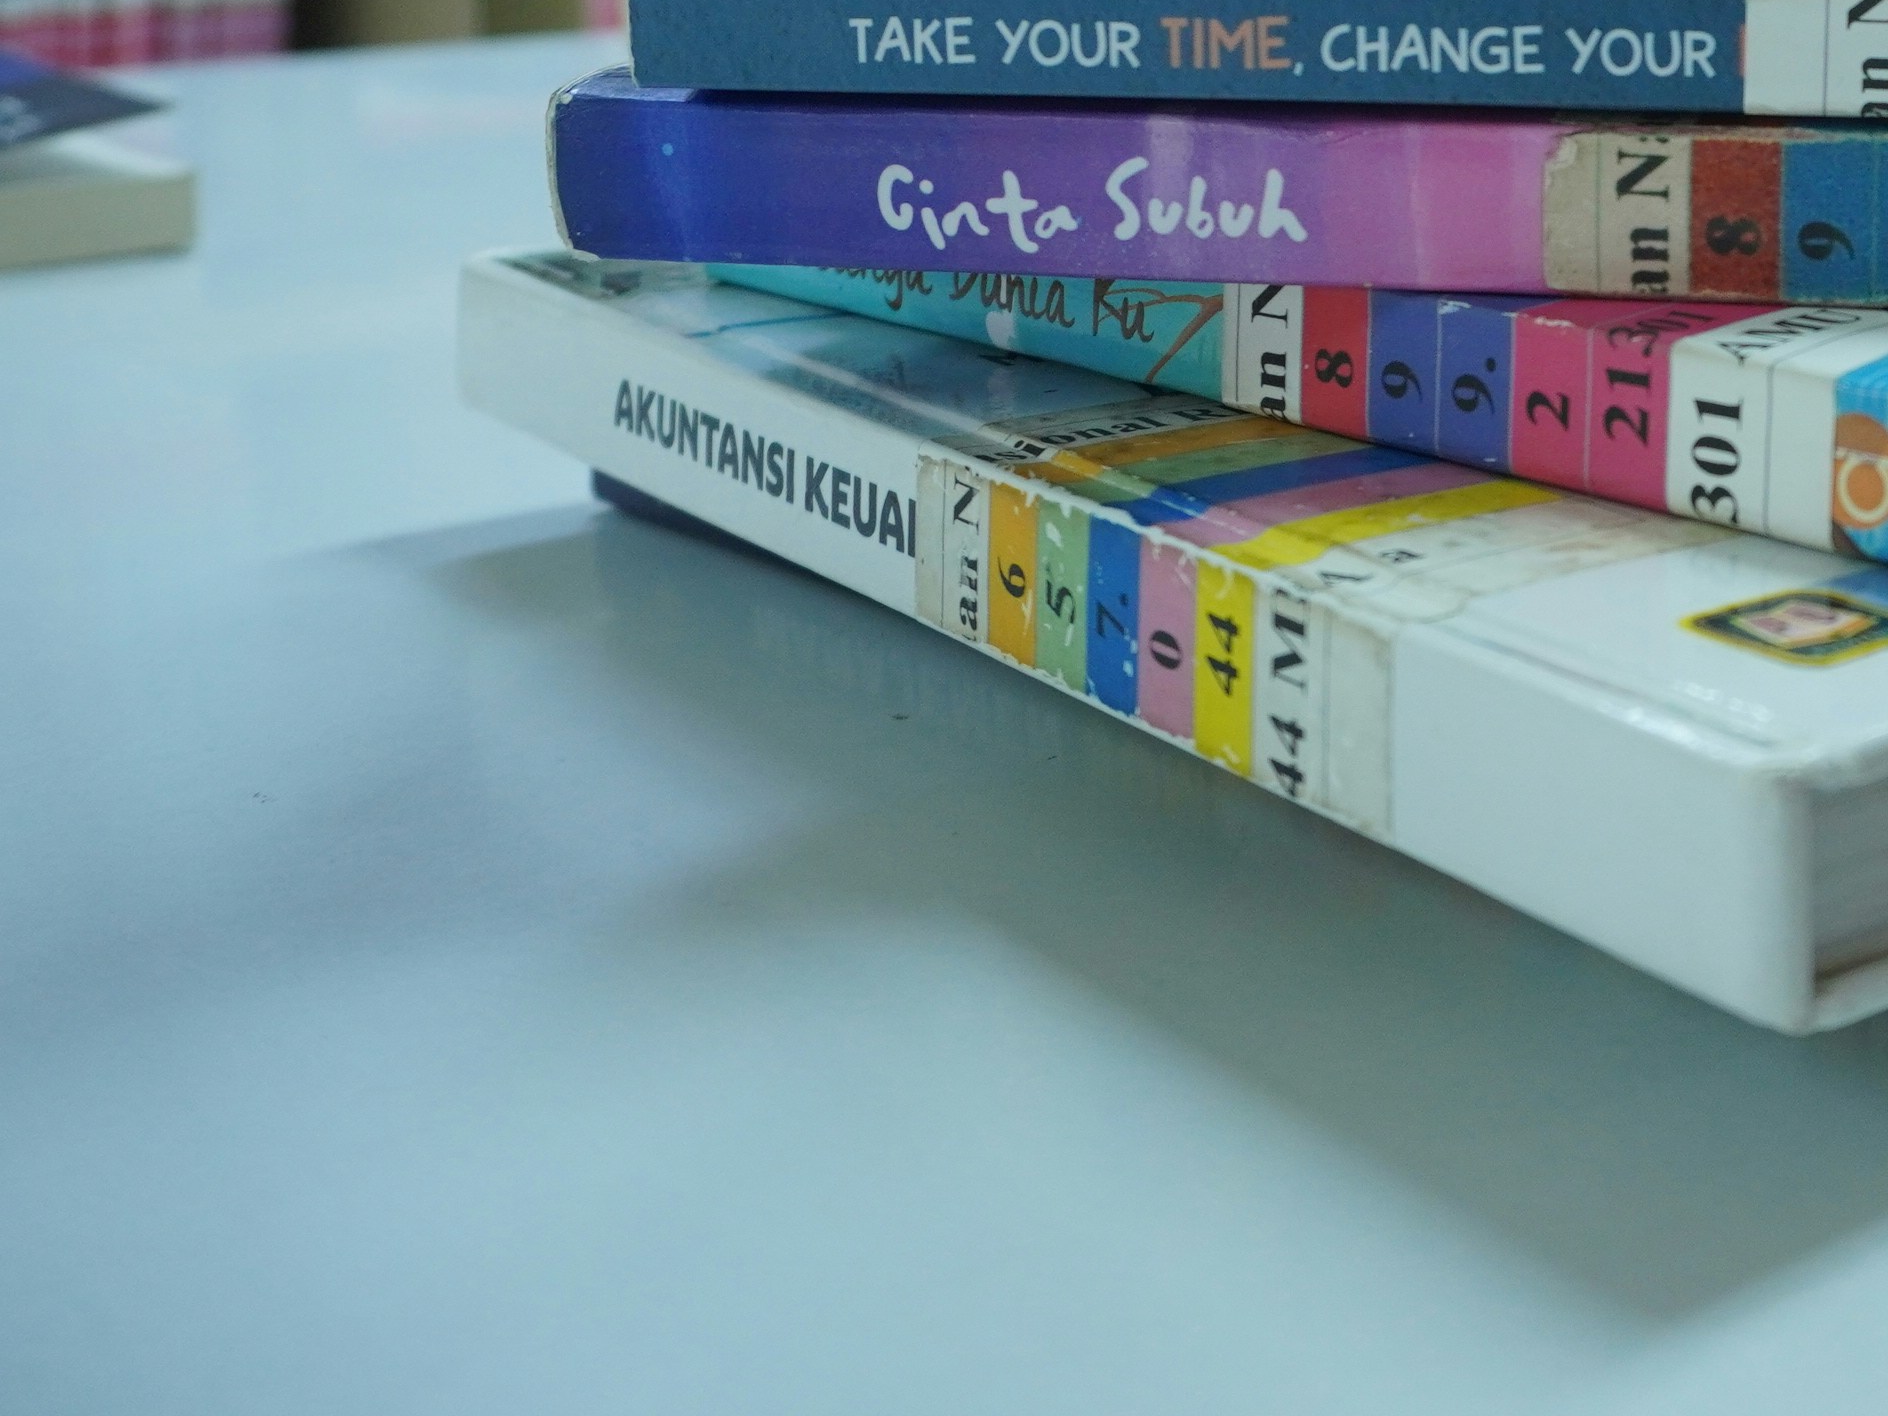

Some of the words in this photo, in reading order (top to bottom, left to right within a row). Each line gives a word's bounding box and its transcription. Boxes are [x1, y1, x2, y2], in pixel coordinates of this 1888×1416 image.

[848, 17, 976, 66] TAKE
[996, 20, 1142, 69] YOUR
[1160, 16, 1305, 75] TIME,
[1320, 24, 1546, 75] CHANGE
[1566, 29, 1718, 78] YOUR
[876, 163, 1079, 254] Cinta
[1105, 156, 1309, 243] Subuh
[1615, 136, 1671, 203] N
[1705, 215, 1761, 257] 8
[1797, 220, 1857, 261] 9
[1314, 348, 1354, 388] 8
[1381, 359, 1423, 404] 9
[1452, 356, 1497, 415] 9.
[1526, 389, 1570, 432] 2
[613, 379, 796, 506] AKUNTANSI
[1690, 397, 1742, 525] 301
[952, 466, 981, 536] N
[960, 548, 979, 642] an
[997, 556, 1026, 599] 6
[1045, 568, 1077, 625] 5
[1095, 592, 1130, 640] 7.
[1149, 629, 1182, 671] 0
[1205, 611, 1239, 697] 44
[1270, 587, 1310, 694] M
[1268, 713, 1305, 797] 44
